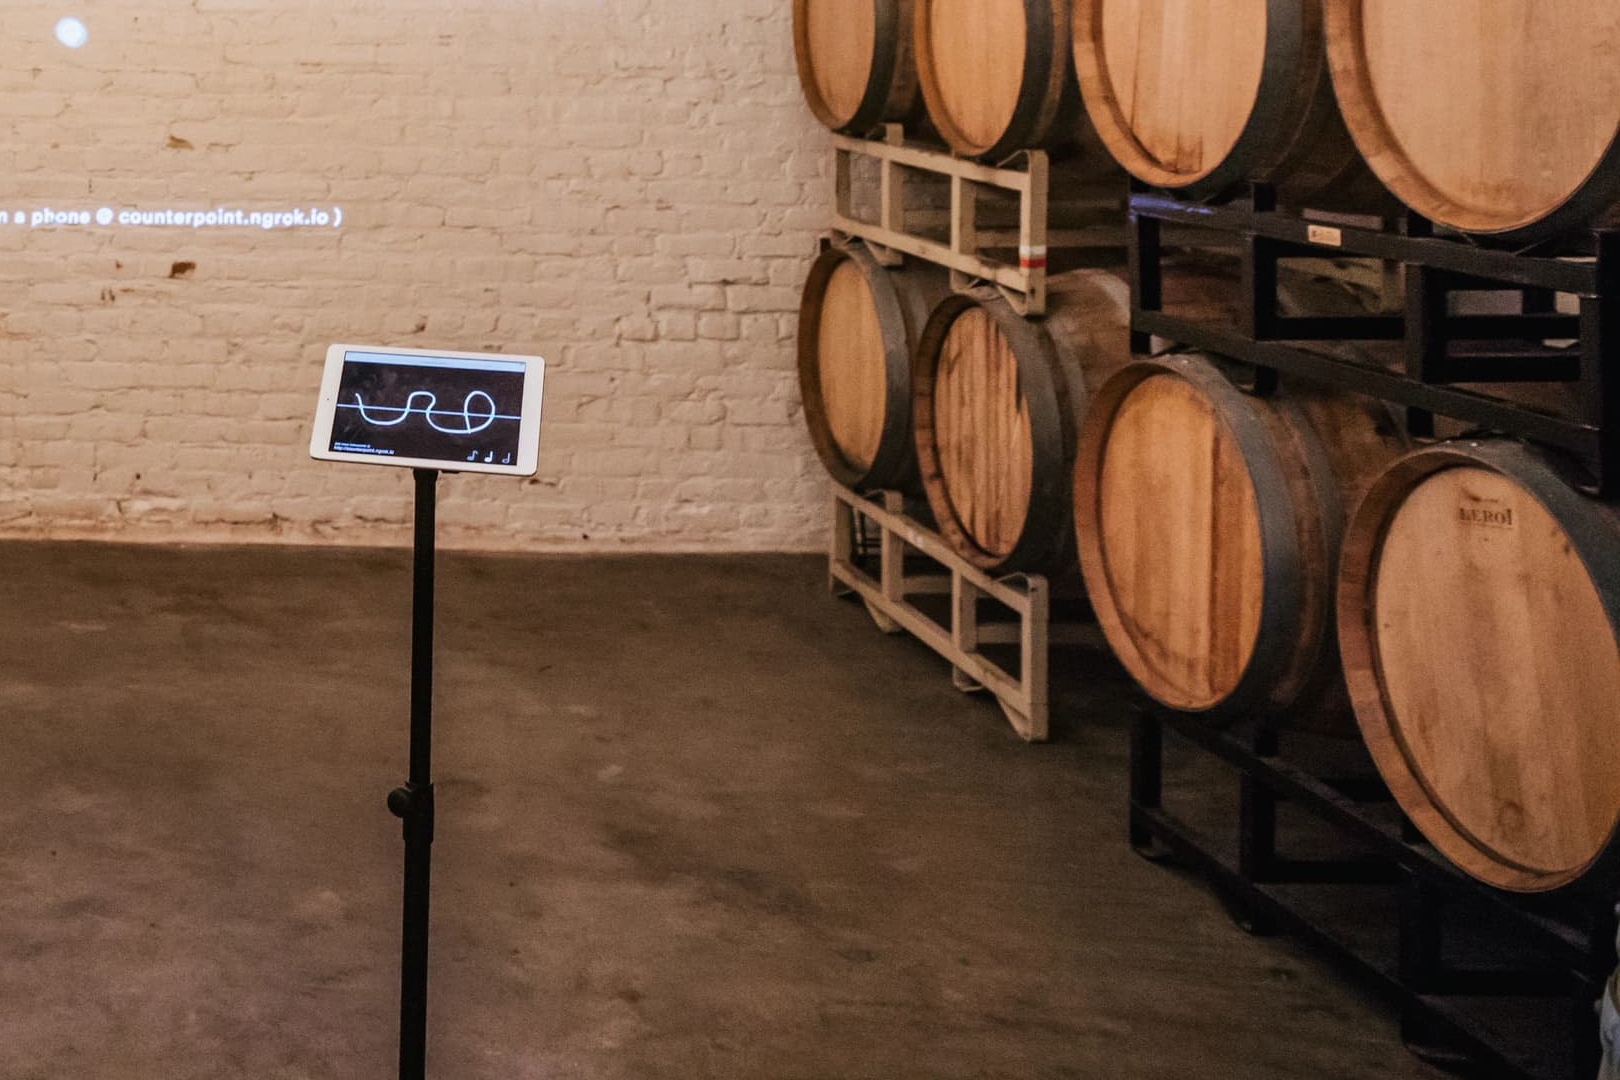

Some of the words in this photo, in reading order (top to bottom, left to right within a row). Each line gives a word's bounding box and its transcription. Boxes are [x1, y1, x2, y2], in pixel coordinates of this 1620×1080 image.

[14, 210, 26, 224] a
[31, 206, 92, 228] phone
[118, 207, 329, 229] counterpoint.ngrok.io
